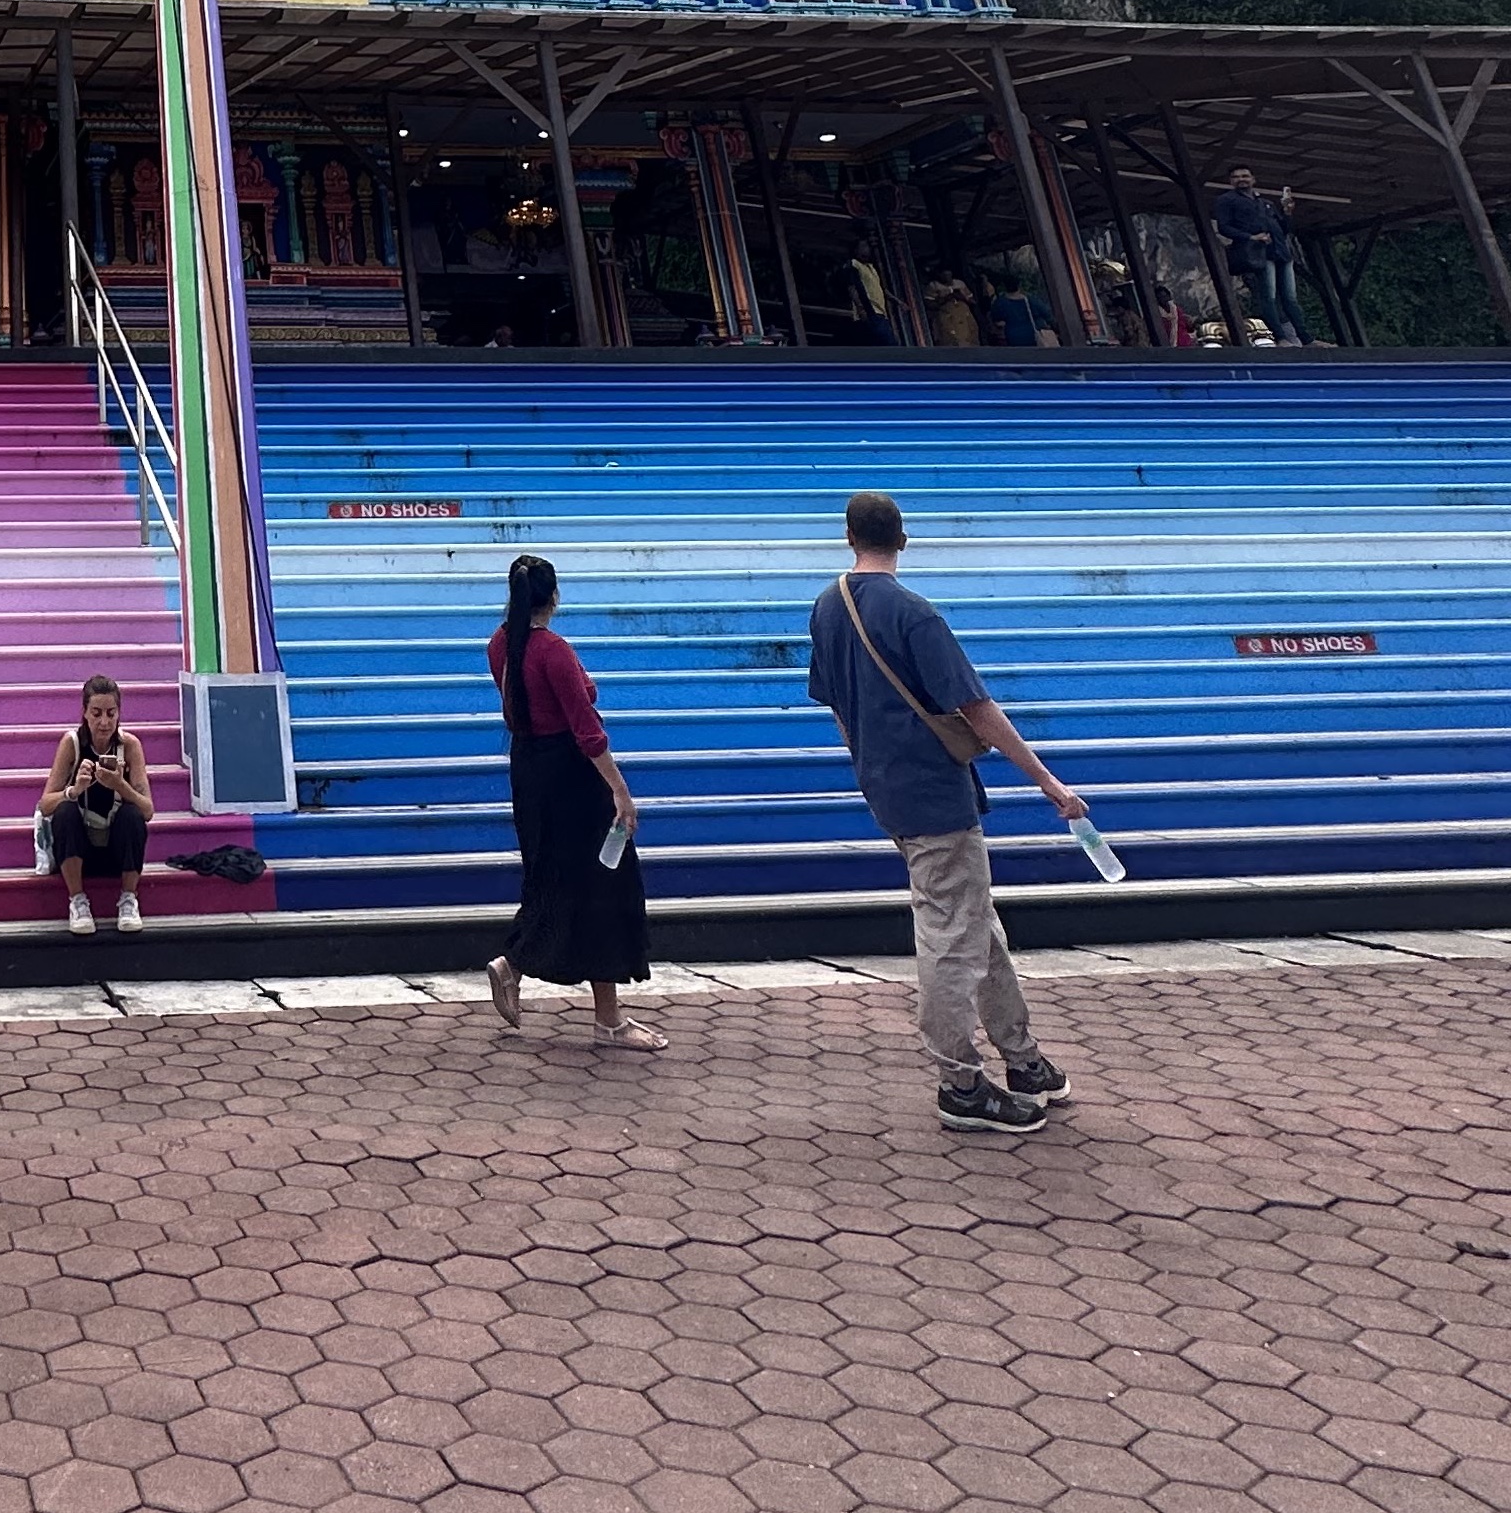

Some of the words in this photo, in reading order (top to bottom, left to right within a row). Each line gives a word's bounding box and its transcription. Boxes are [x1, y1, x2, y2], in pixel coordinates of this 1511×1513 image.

[360, 503, 386, 517] NO
[390, 503, 450, 517] SHOES
[1270, 638, 1298, 653] NO
[1302, 636, 1366, 652] SHOES
